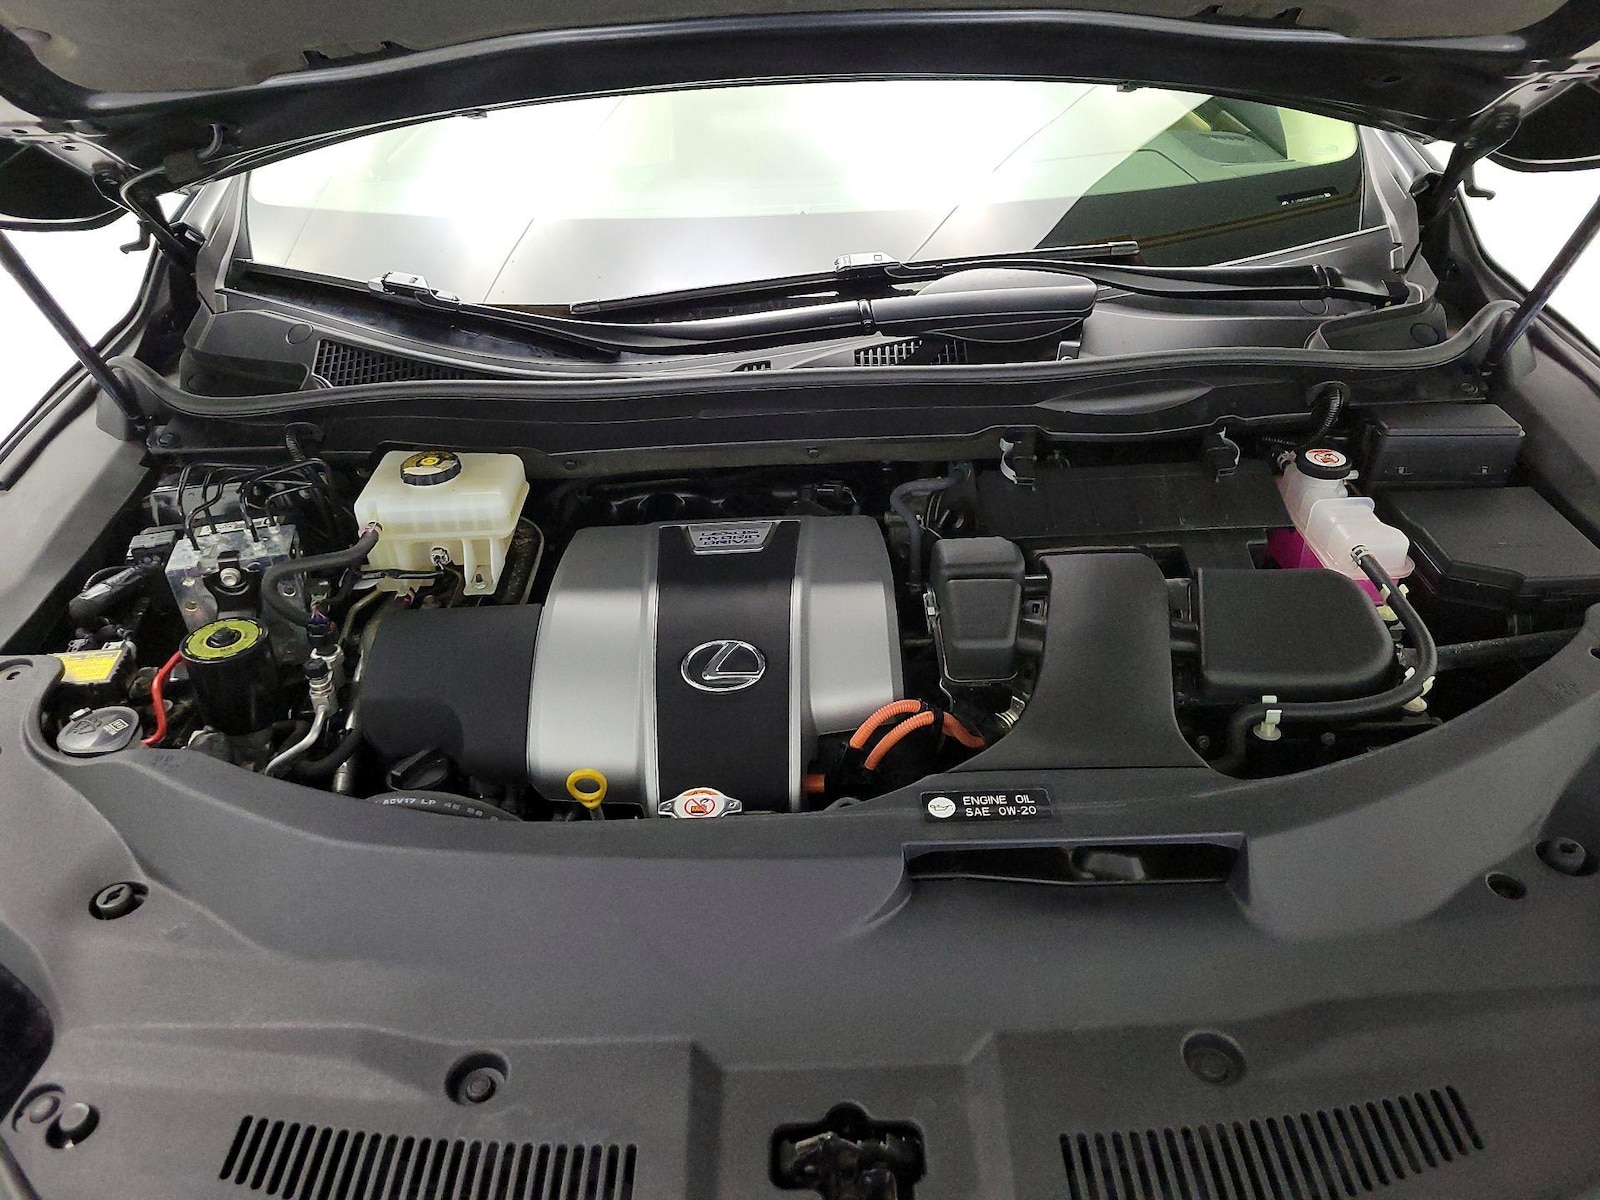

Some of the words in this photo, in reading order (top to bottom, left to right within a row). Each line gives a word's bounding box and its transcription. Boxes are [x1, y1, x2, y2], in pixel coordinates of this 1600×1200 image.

[962, 795, 1007, 806] ENGINE
[1015, 794, 1035, 804] OIL
[965, 806, 991, 817] SAE
[998, 805, 1037, 816] 0W-20
